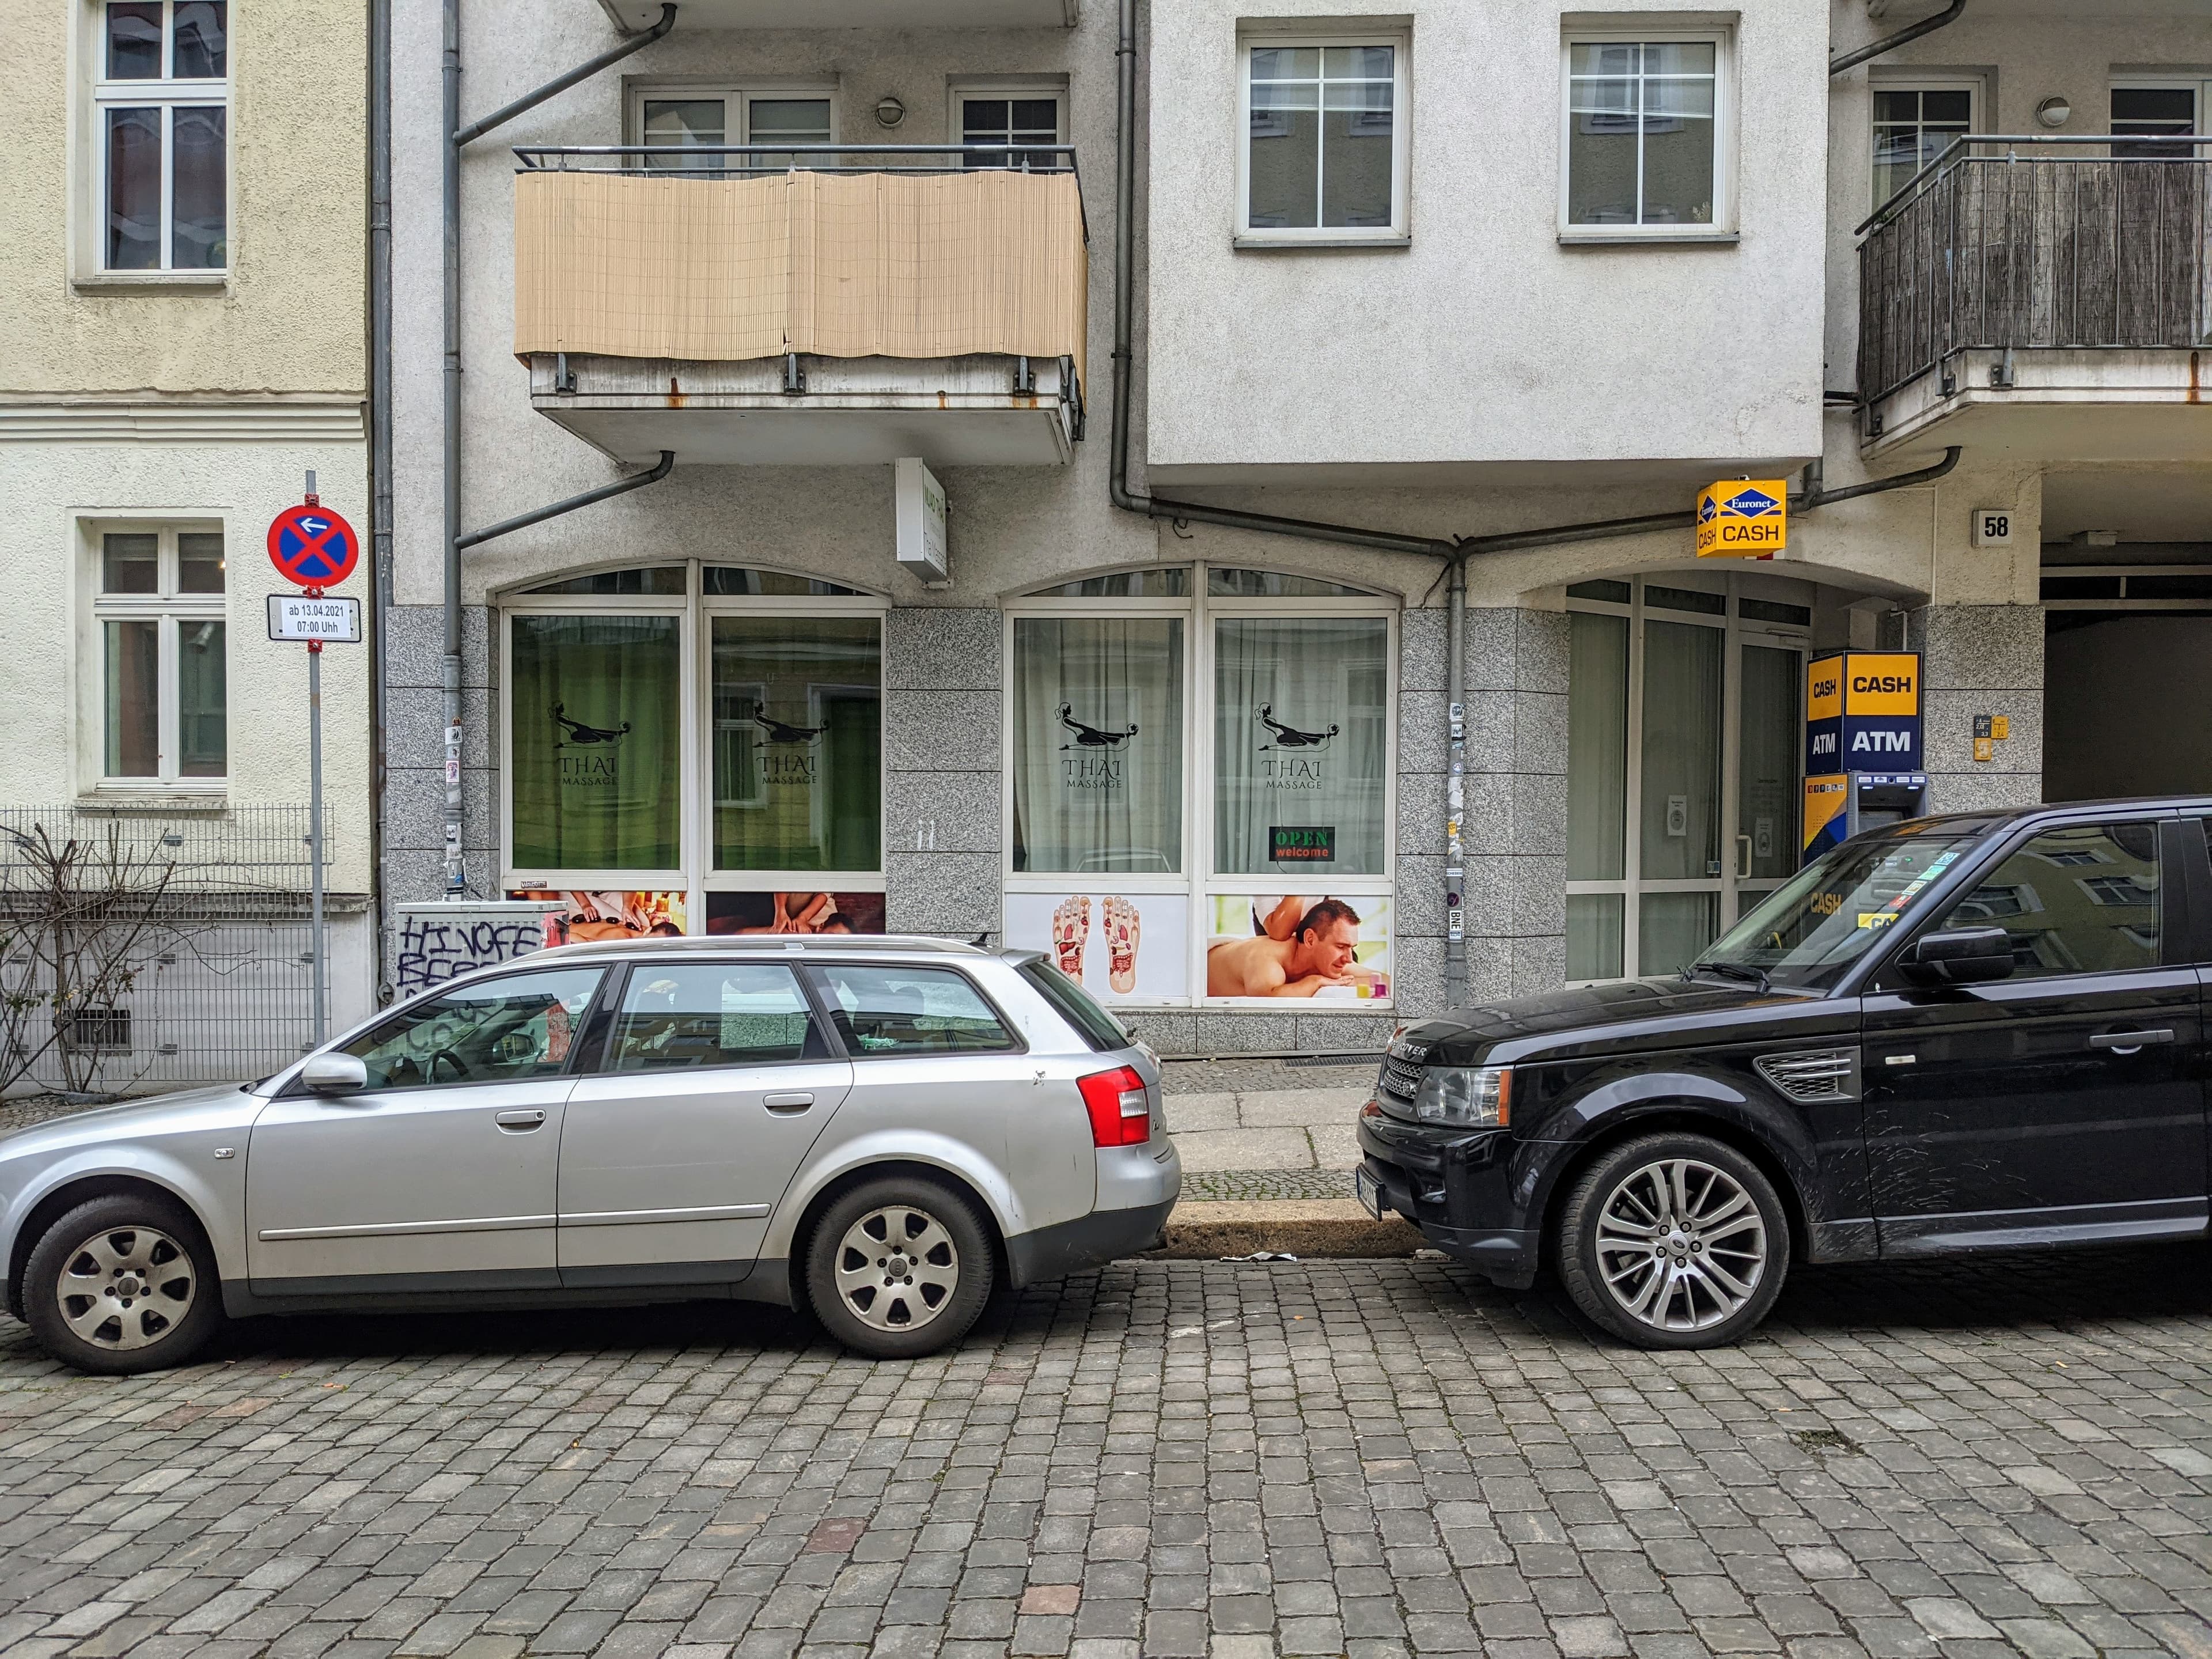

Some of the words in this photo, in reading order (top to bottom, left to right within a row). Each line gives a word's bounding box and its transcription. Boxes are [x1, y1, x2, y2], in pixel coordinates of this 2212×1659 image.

[1701, 504, 1714, 516] Euronet
[1732, 499, 1772, 508] Euronet
[1723, 525, 1779, 541] CASH
[1984, 517, 2008, 537] 58
[1699, 528, 1716, 549] CASH
[289, 604, 299, 615] ab
[302, 605, 343, 616] 13.04.2021
[297, 621, 319, 632] 07:00
[1814, 679, 1836, 698] CASH
[1853, 676, 1911, 693] CASH
[1813, 733, 1836, 755] ATM
[1851, 732, 1910, 752] ATM
[556, 756, 614, 777] THAI
[756, 755, 816, 775] THAI
[1062, 758, 1120, 779] THAI
[1262, 759, 1320, 781] THAI
[563, 777, 618, 785] MASSAGE
[762, 776, 817, 784] MASSAGE
[1067, 780, 1122, 788] MASSAGE
[1266, 781, 1321, 789] MASSAGE
[1276, 832, 1327, 846] OPEN
[1276, 847, 1328, 857] welcome
[1810, 893, 1842, 915] CASH
[1451, 912, 1461, 929] BNE
[1399, 1043, 1427, 1056] ROVER
